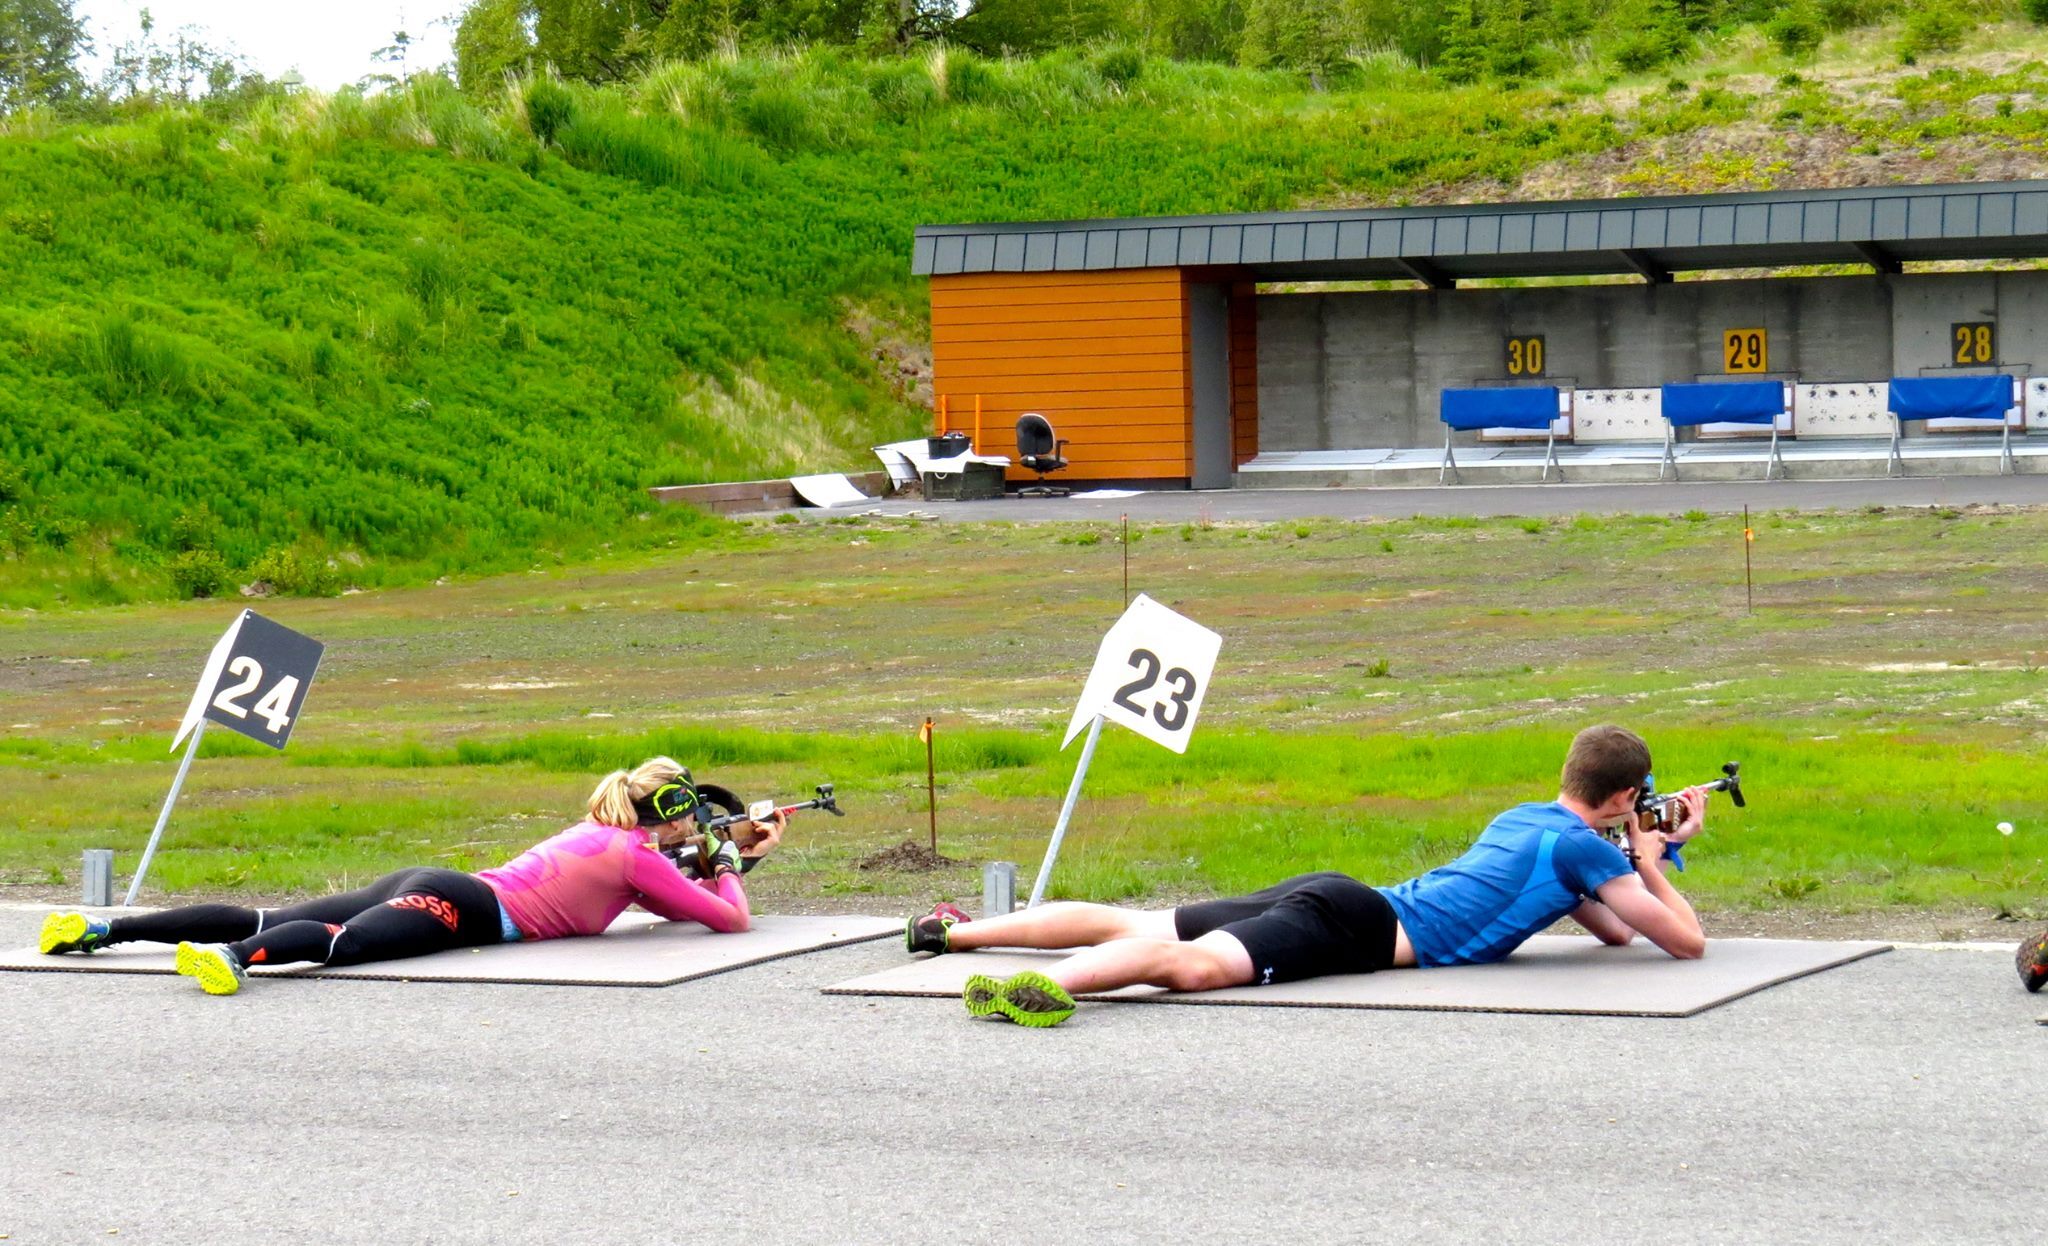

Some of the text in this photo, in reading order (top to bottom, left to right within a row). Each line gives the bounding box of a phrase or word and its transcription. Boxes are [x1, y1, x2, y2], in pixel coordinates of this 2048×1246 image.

[1508, 338, 1542, 375] 30
[1729, 333, 1761, 369] 29
[1956, 326, 1991, 363] 28
[212, 655, 300, 734] 24
[1112, 648, 1197, 732] 23
